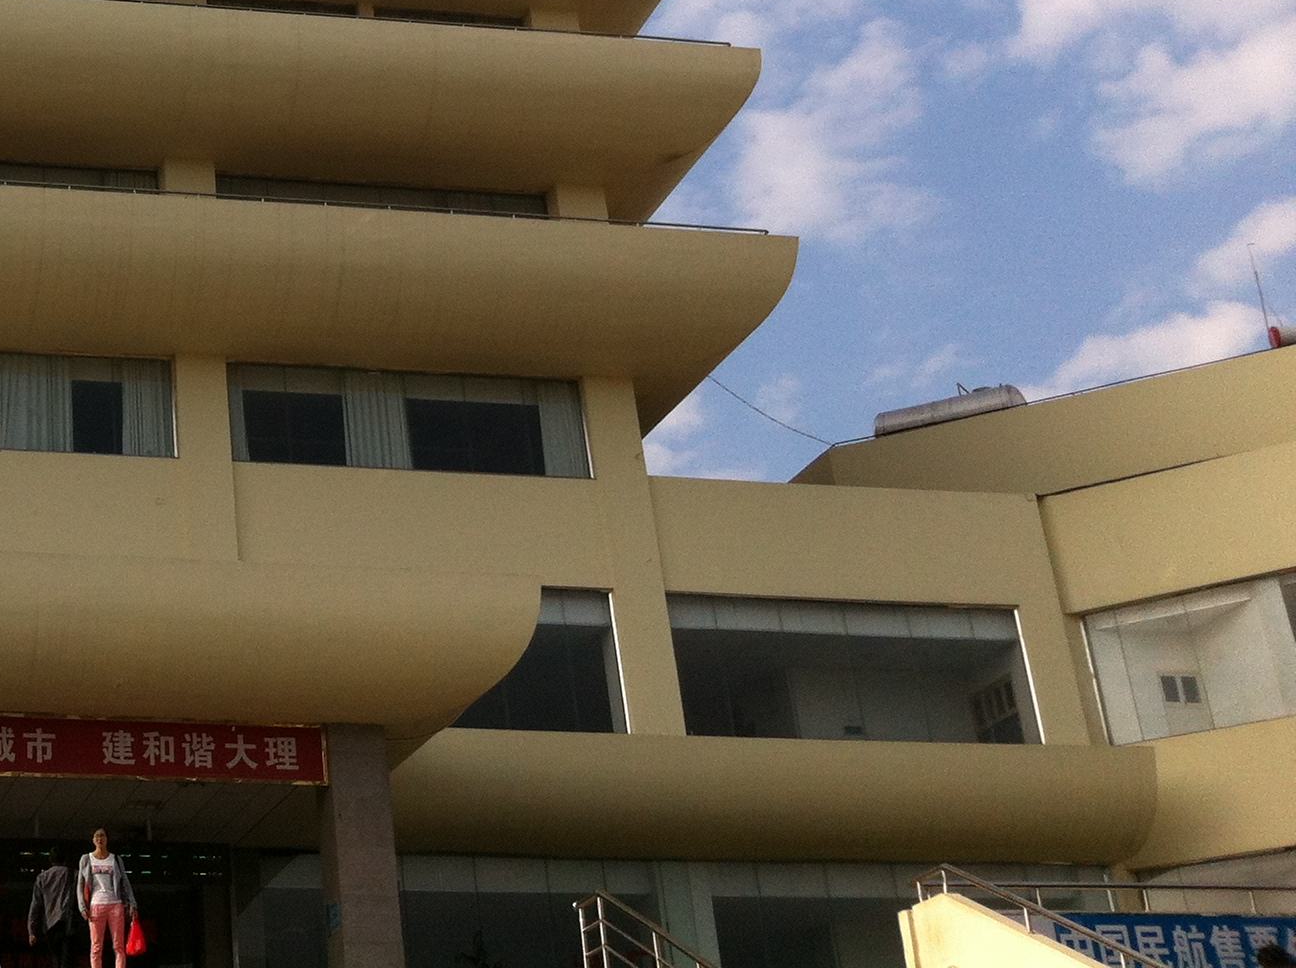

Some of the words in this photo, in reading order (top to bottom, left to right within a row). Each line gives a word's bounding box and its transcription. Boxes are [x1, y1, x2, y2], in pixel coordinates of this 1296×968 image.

[102, 730, 299, 772] 建和谐大理
